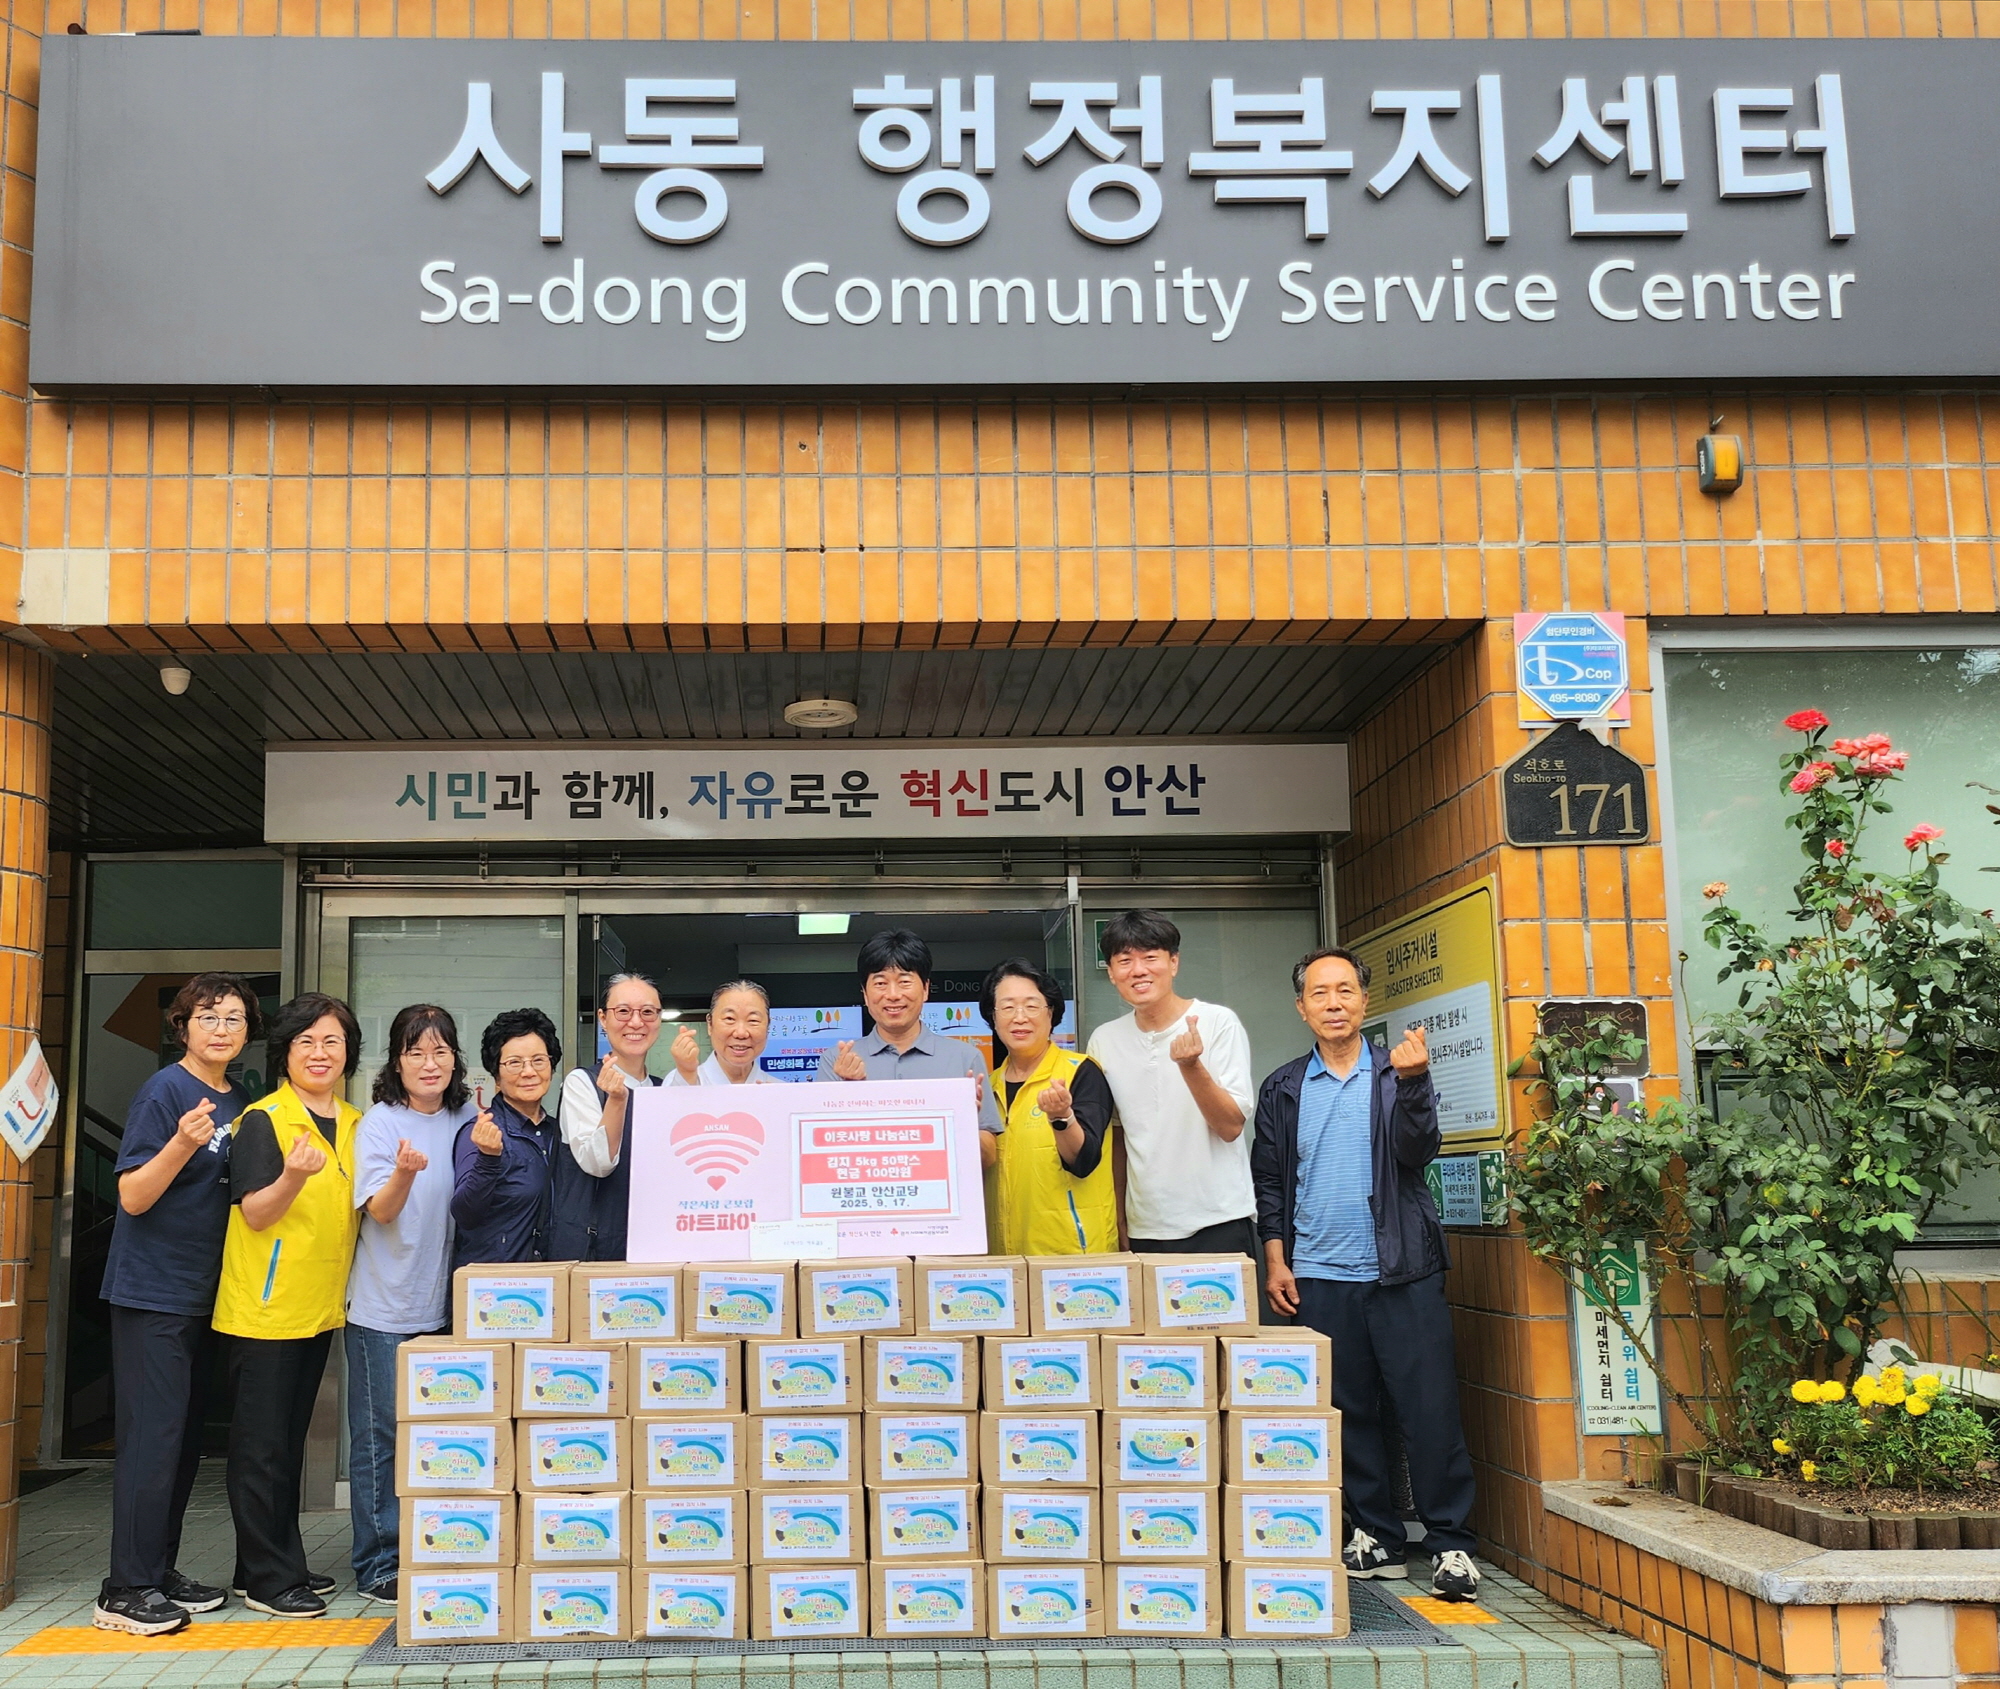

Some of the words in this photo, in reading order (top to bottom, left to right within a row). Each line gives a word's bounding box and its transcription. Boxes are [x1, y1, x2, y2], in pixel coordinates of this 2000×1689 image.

[425, 72, 764, 244] 사동
[853, 74, 1855, 245] 행정복지센터
[419, 258, 747, 343] Sa-dong
[781, 259, 1250, 343] Community
[1279, 258, 1557, 324] Service
[1588, 260, 1855, 322] Center
[1545, 627, 1596, 637] 첨단무인경비
[1585, 668, 1612, 680] Cop
[1548, 693, 1600, 703] 495-8080
[1523, 757, 1567, 773] 석호로
[1513, 773, 1567, 784] Seokho-ro
[395, 771, 541, 821] 시민과
[562, 770, 669, 820] 함께,
[687, 769, 879, 819] 자유로운
[900, 767, 1084, 818] 혁신도시
[1104, 763, 1206, 817] 안산
[1549, 782, 1641, 835] 171
[1386, 929, 1438, 976] 임시주거시설
[1384, 976, 1414, 1001] (DISASTER
[1414, 964, 1444, 990] SHELTER)
[208, 1123, 232, 1154] FLORID
[704, 1124, 730, 1132] ANSAN
[855, 1157, 878, 1167] 5kg
[865, 1166, 912, 1178] 100만원
[831, 1187, 866, 1198] 원불교
[871, 1185, 919, 1197] 안산교당
[840, 1199, 872, 1208] 2025.
[877, 1199, 887, 1208] 9.
[893, 1198, 910, 1207] 17.
[1595, 1311, 1610, 1369] 미세먼지
[1600, 1373, 1613, 1402] 쉼터
[1624, 1367, 1640, 1401] 쉼터
